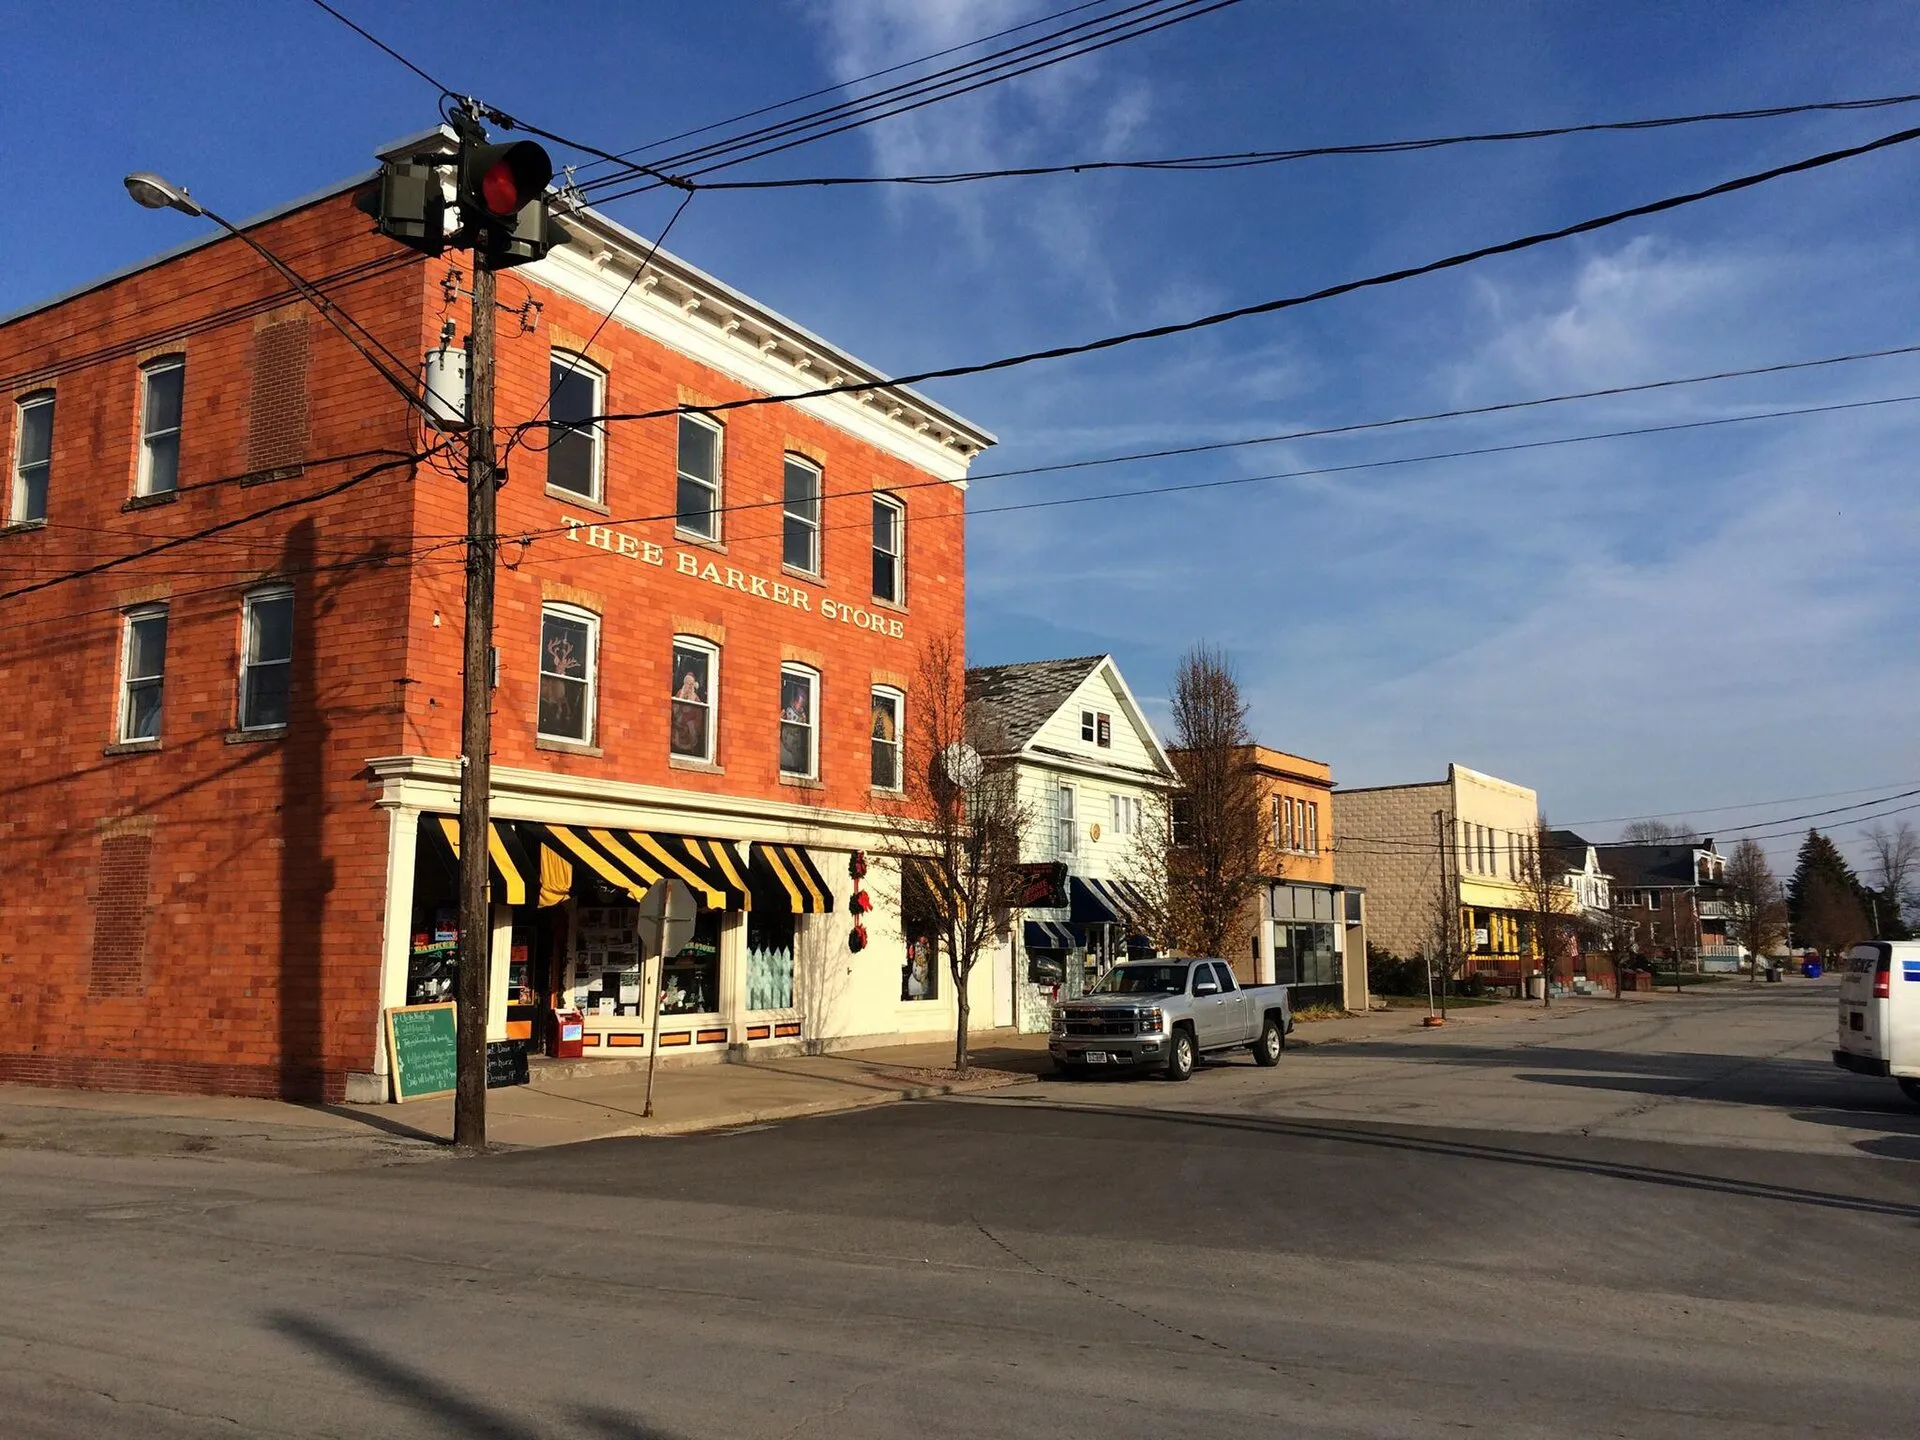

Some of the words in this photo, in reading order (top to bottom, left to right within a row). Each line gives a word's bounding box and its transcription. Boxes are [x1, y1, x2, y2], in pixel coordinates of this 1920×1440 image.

[560, 515, 664, 567] THEE
[676, 551, 812, 612] BARKER
[821, 598, 905, 640] STORE
